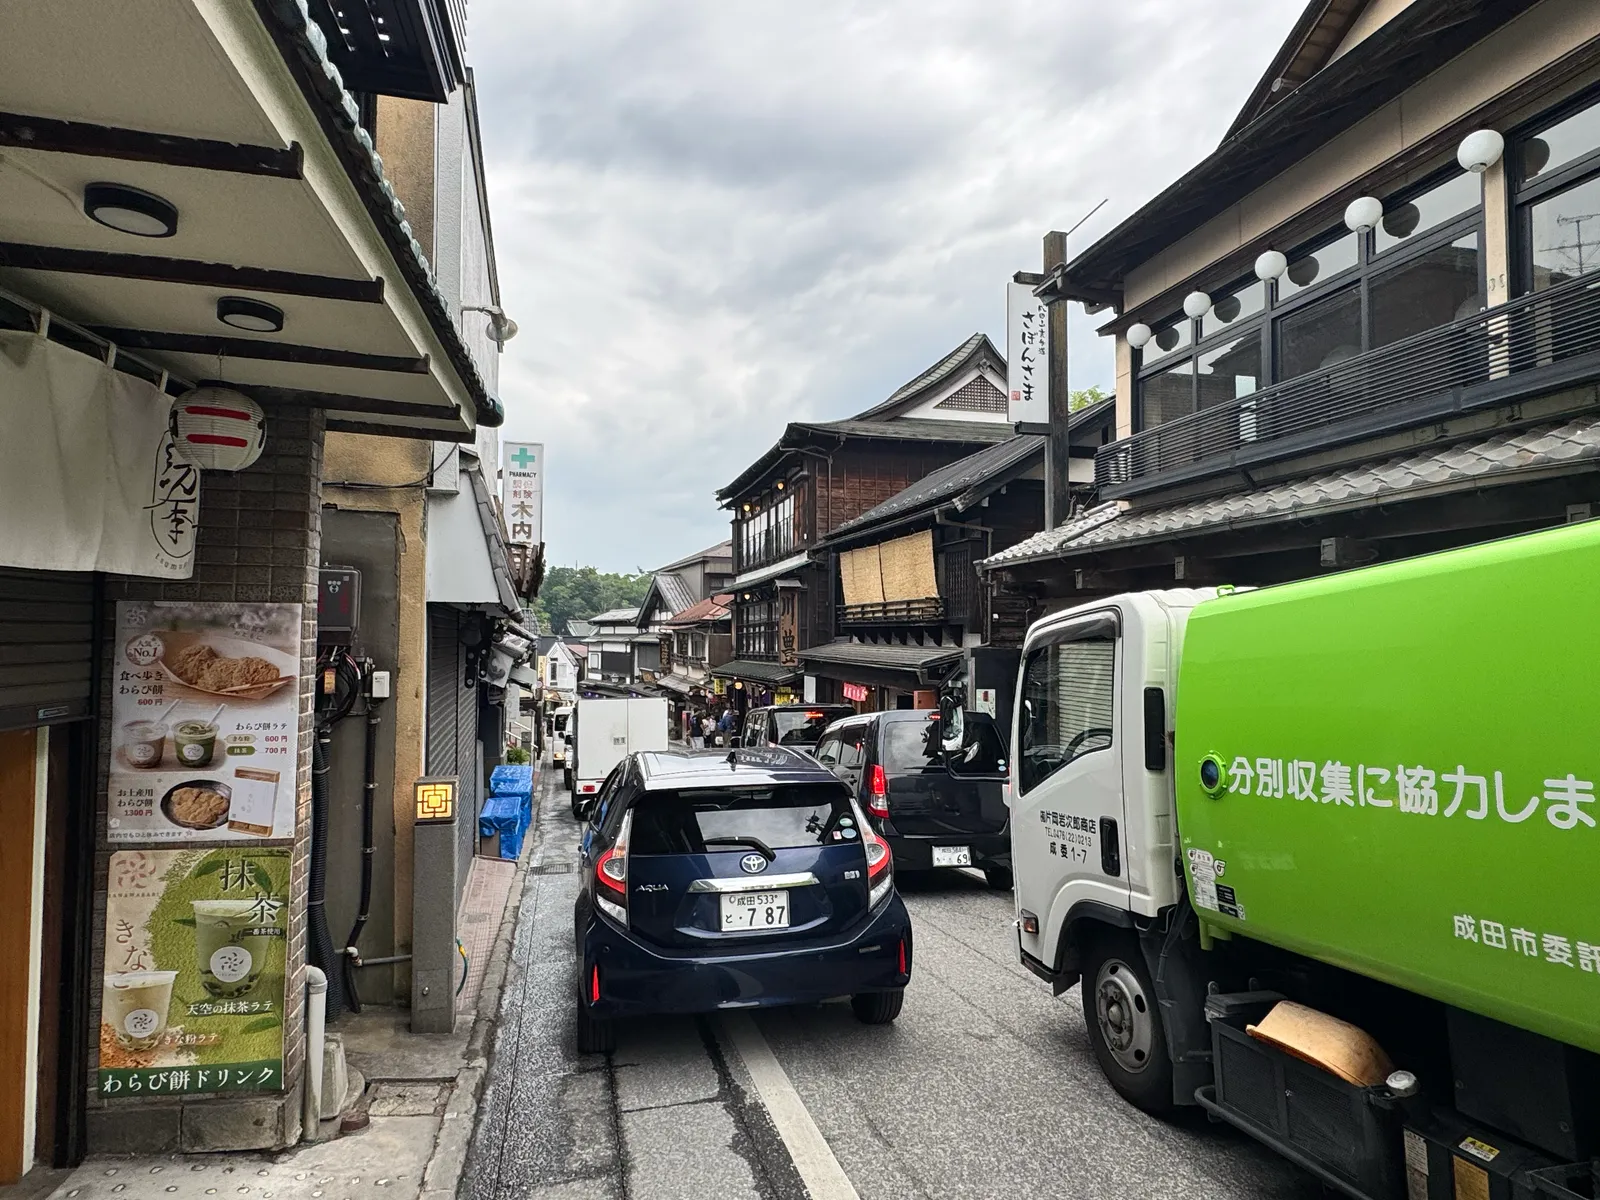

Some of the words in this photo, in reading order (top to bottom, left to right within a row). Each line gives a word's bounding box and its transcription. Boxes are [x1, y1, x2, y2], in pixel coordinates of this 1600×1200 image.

[509, 471, 537, 479] PHARMACY
[511, 501, 534, 546] 木内
[133, 647, 158, 658] No.1
[119, 670, 164, 681] 食べ歩き
[119, 684, 164, 695] わらび餅
[235, 722, 288, 731] わらび餅ラテ
[117, 788, 154, 797] お土産用
[1228, 756, 1597, 830] 分別収集に協力しま
[117, 799, 153, 807] わらび餅
[219, 859, 281, 925] 抹茶
[635, 884, 670, 893] AQUA
[112, 918, 148, 989] きなこ
[186, 1000, 273, 1016] 天空の抹茶ラテ
[164, 1033, 219, 1047] きな粉ラテ
[102, 1067, 275, 1094] わらび餅ドリンク
